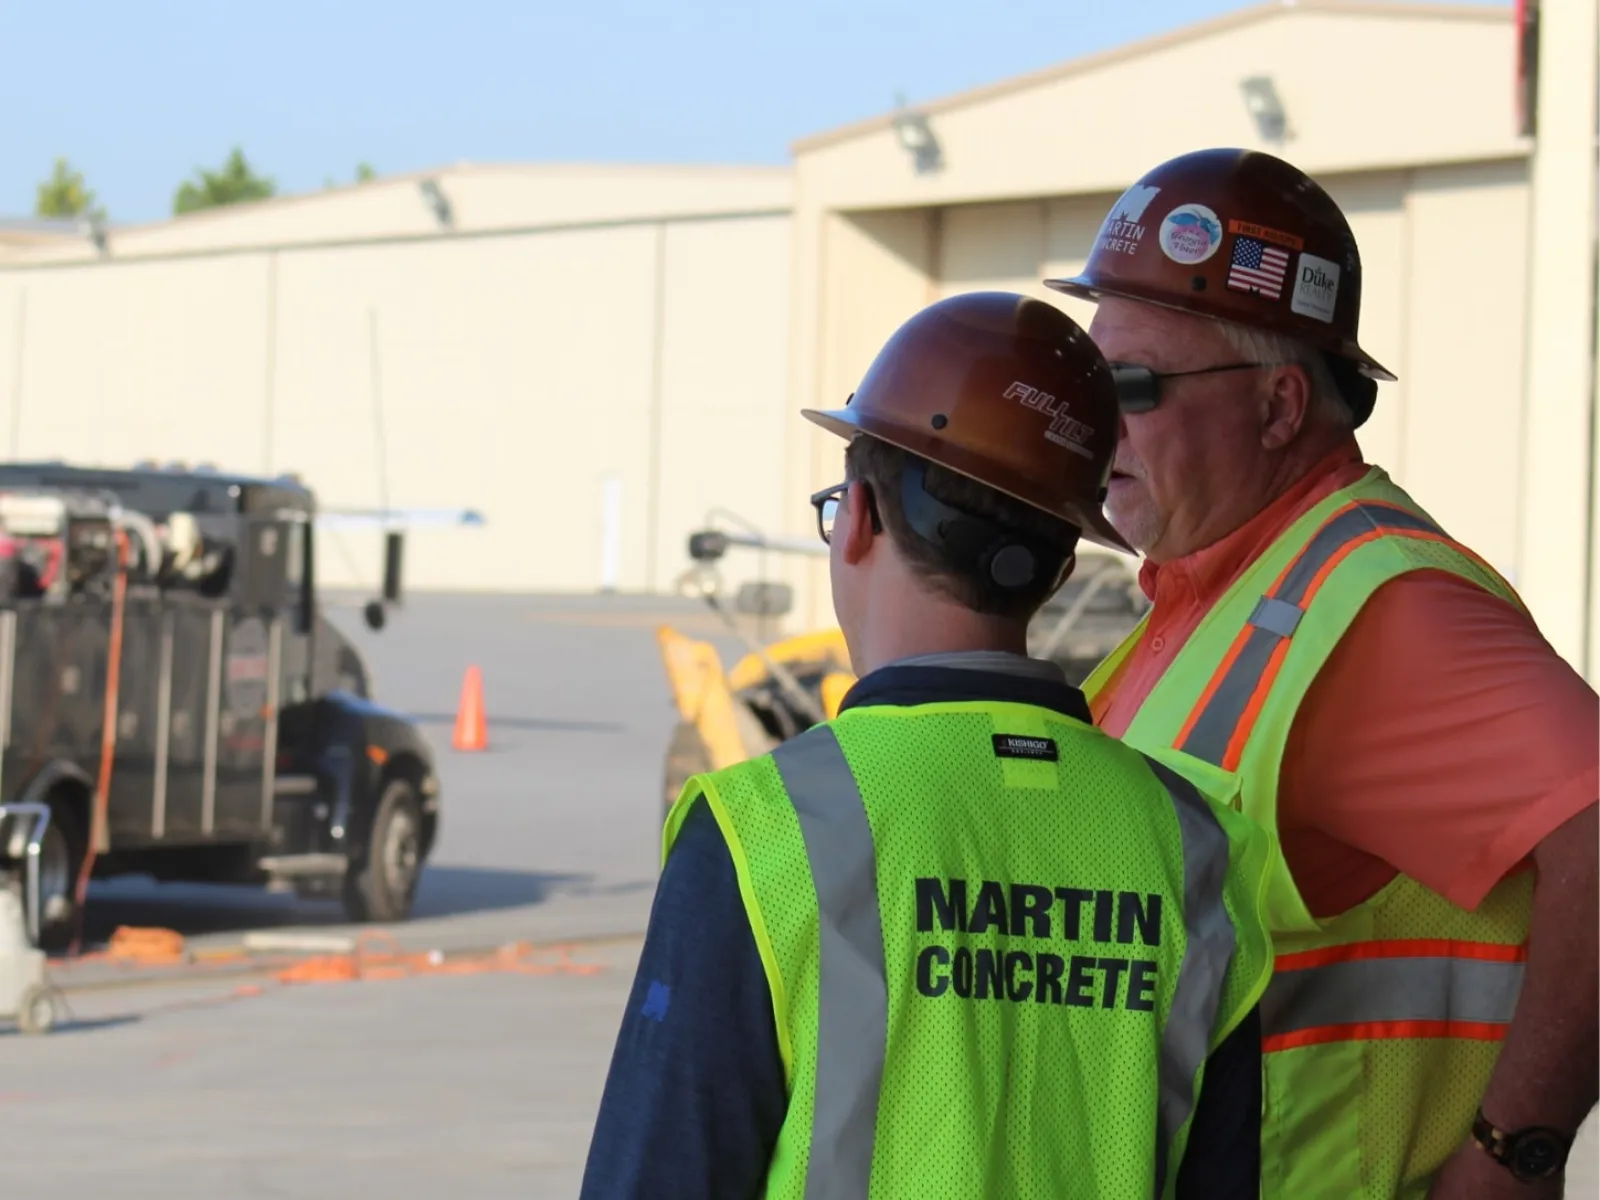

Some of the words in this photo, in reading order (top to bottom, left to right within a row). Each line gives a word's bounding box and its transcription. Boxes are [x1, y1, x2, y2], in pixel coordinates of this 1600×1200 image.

[1107, 219, 1146, 241] ARTIN
[1302, 267, 1335, 291] Duke
[1002, 381, 1072, 420] FULL
[1007, 738, 1048, 749] KISHIGO
[915, 877, 1163, 947] MARTIN
[915, 945, 1159, 1012] CONCRETE
